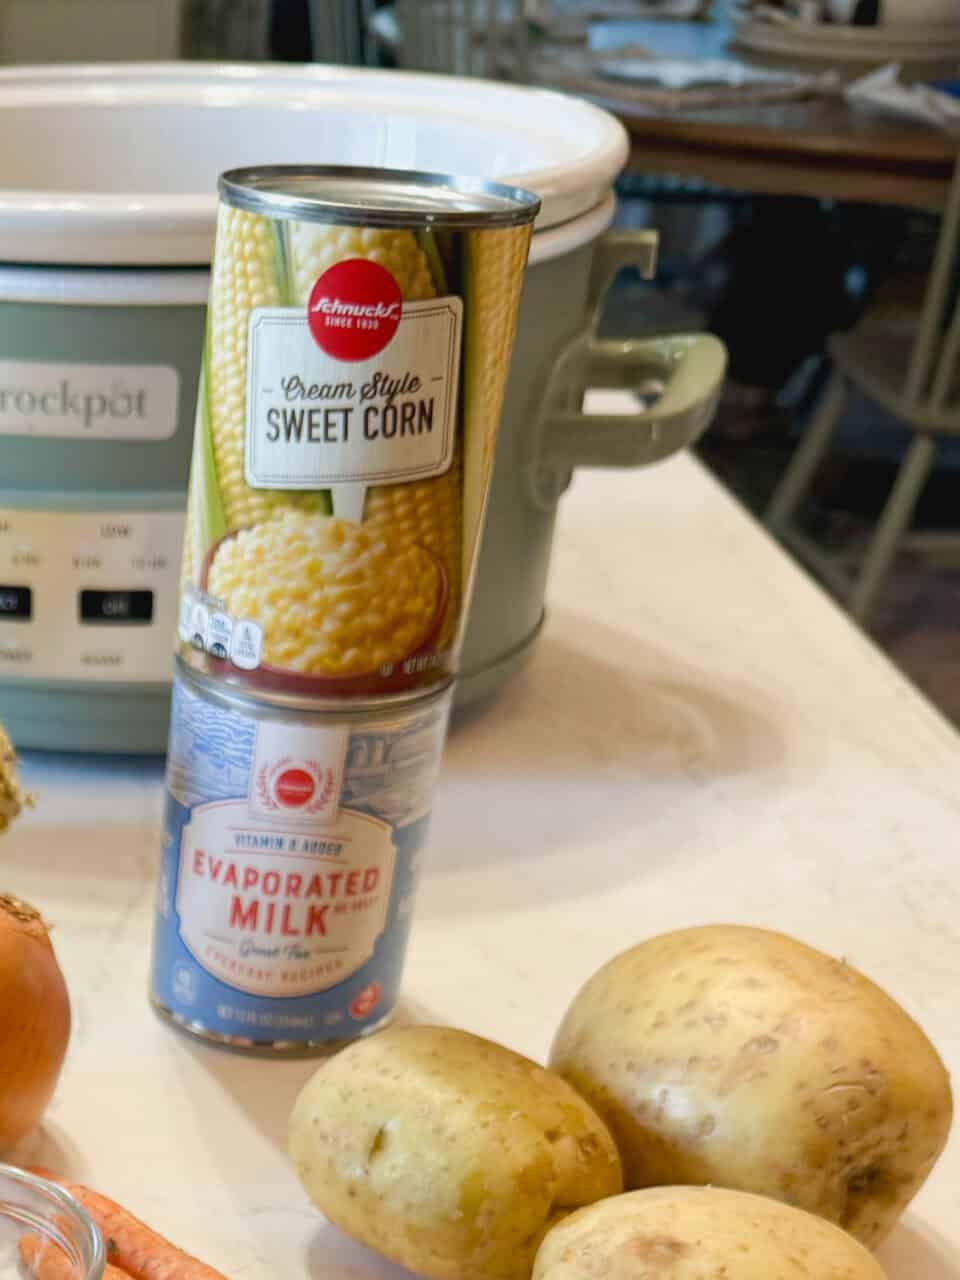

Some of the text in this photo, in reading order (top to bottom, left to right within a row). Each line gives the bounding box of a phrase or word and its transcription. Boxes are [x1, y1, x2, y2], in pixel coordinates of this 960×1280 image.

[311, 298, 399, 319] Schnucks
[325, 317, 352, 328] SINCE
[281, 372, 422, 404] Cream Style
[266, 398, 434, 443] SWEET CORN
[234, 833, 283, 849] VITAMIN
[192, 848, 380, 897] EVAPORATED
[230, 895, 329, 937] MILK
